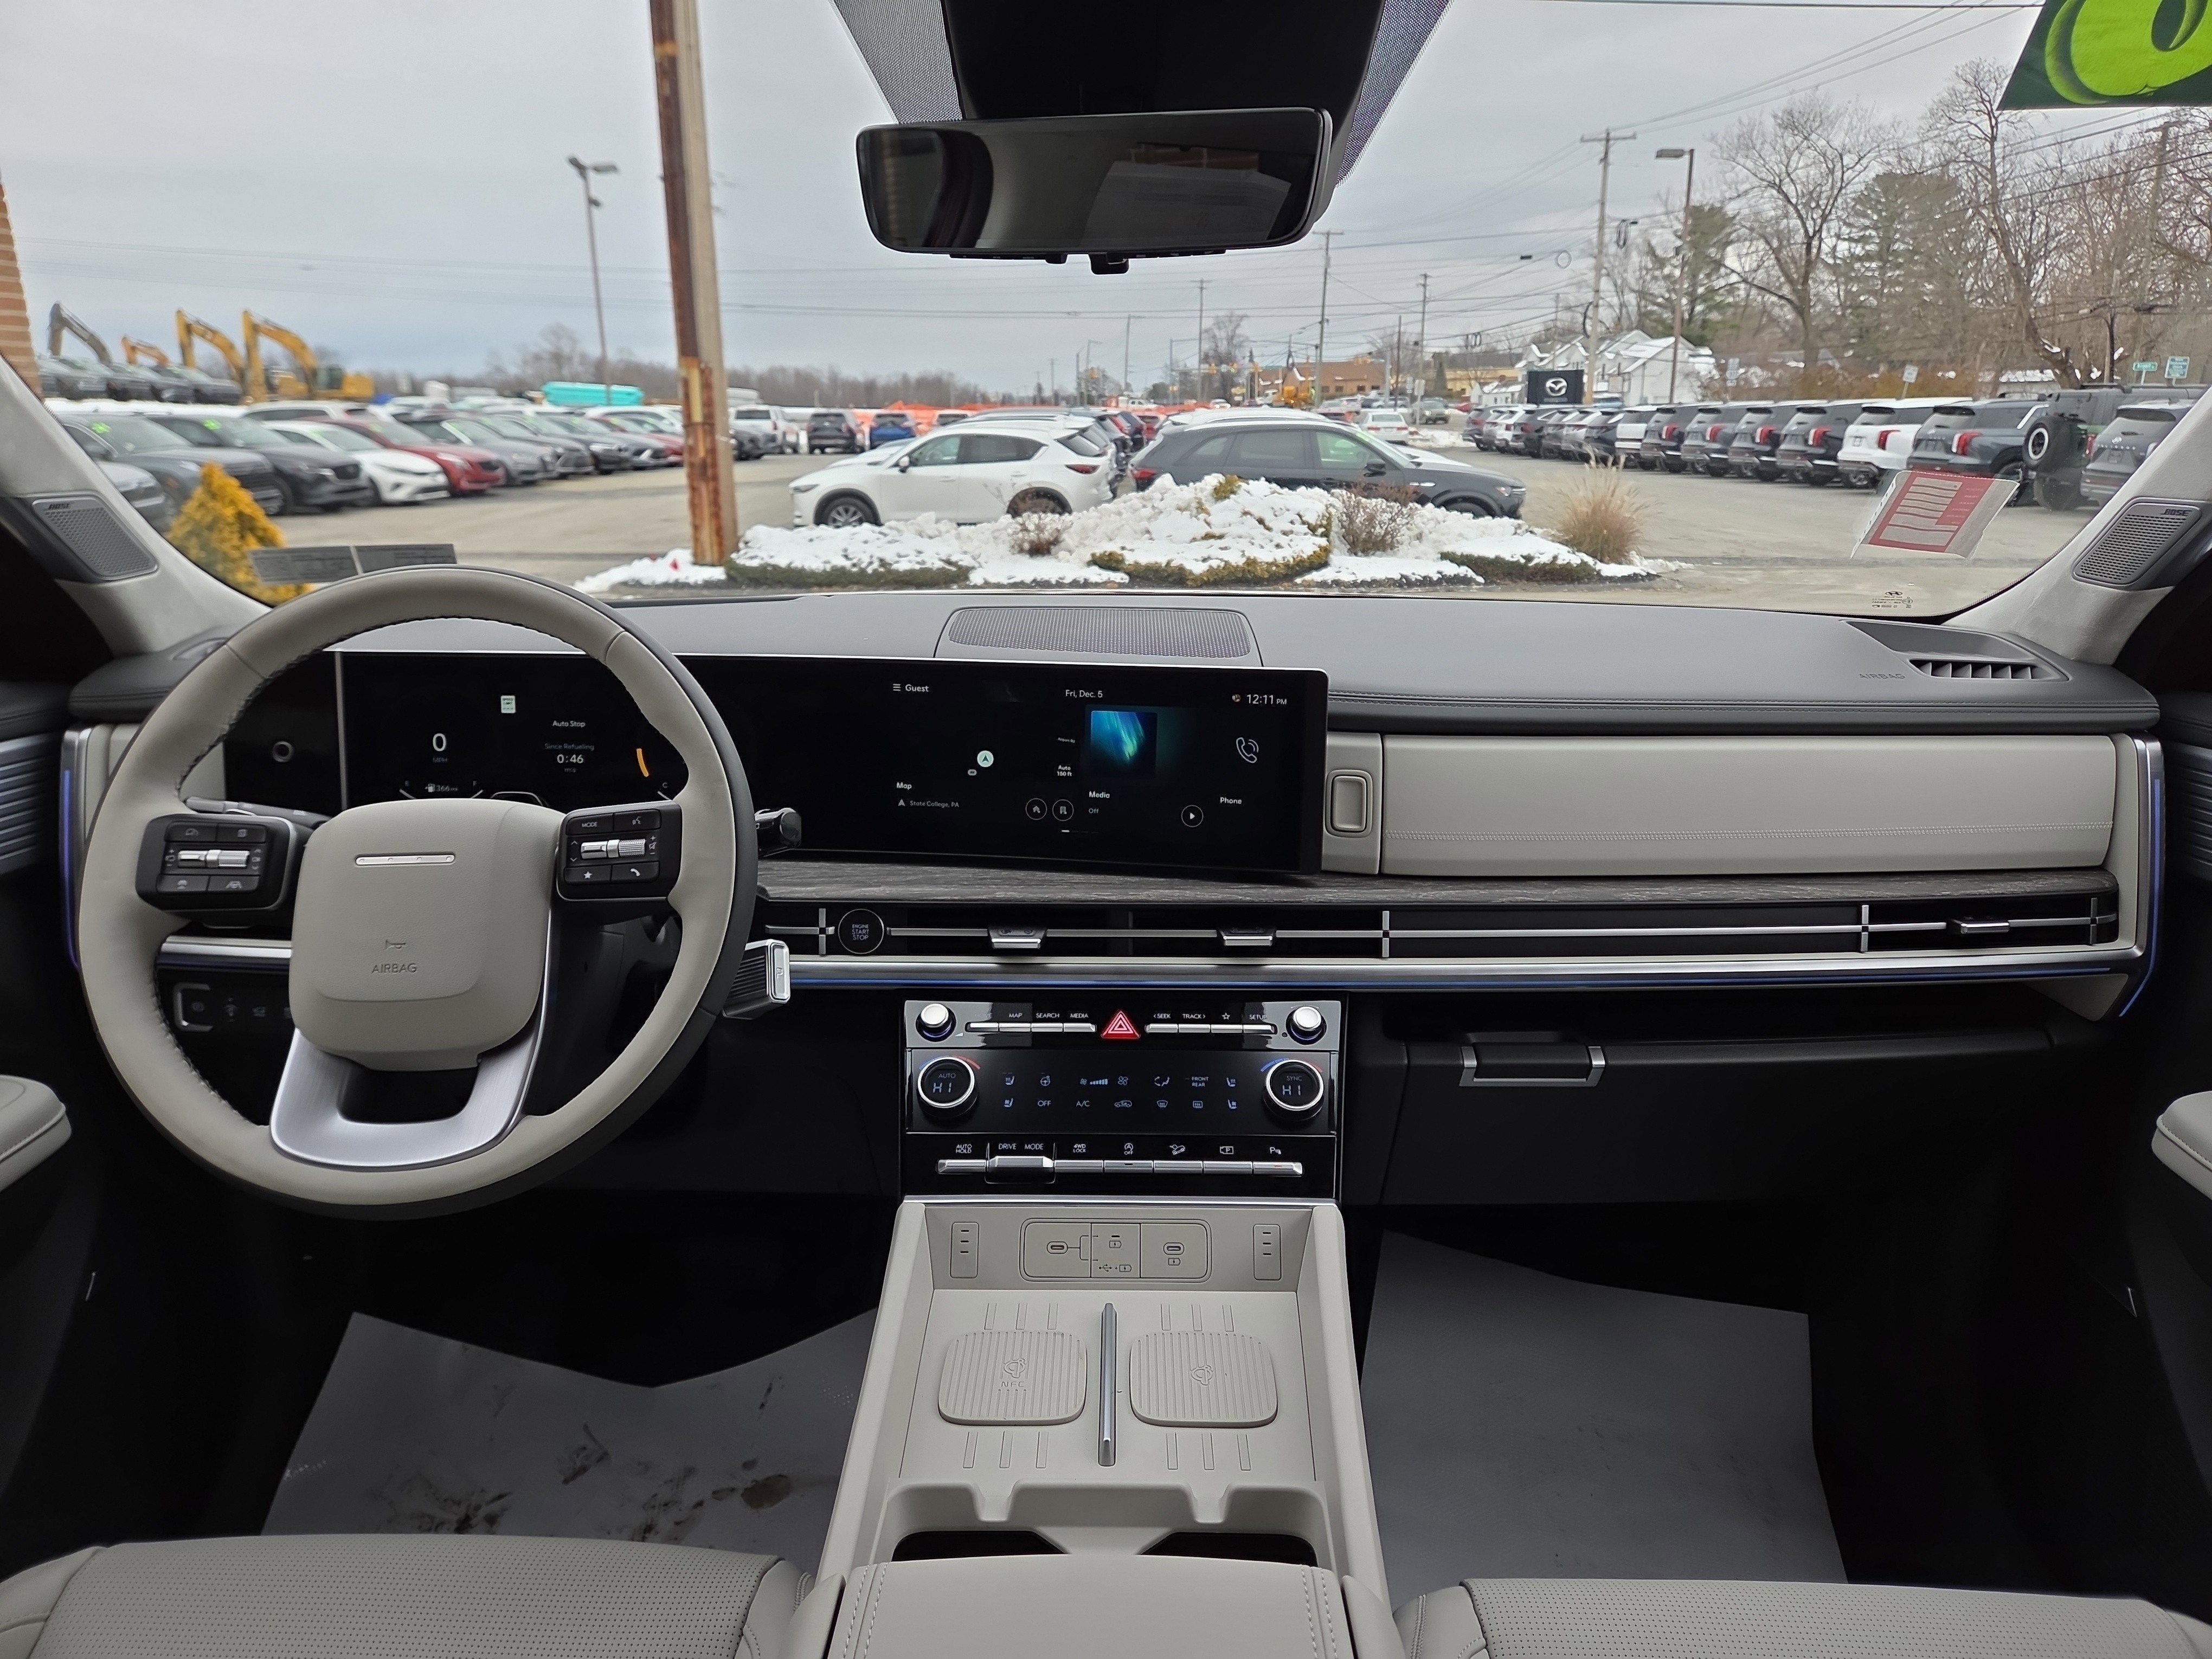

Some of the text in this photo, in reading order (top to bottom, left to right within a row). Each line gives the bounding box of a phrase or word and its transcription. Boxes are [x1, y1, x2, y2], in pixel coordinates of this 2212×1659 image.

[905, 684, 929, 692] Guest
[1065, 689, 1077, 698] Fri,
[1246, 694, 1274, 704] 12:11
[570, 721, 586, 729] Stop
[432, 733, 447, 751] 0
[563, 743, 595, 751] Refueling
[556, 754, 584, 764] 0:46
[896, 782, 912, 790] Map
[1220, 796, 1242, 805] Phone
[371, 963, 417, 974] AIRBAG
